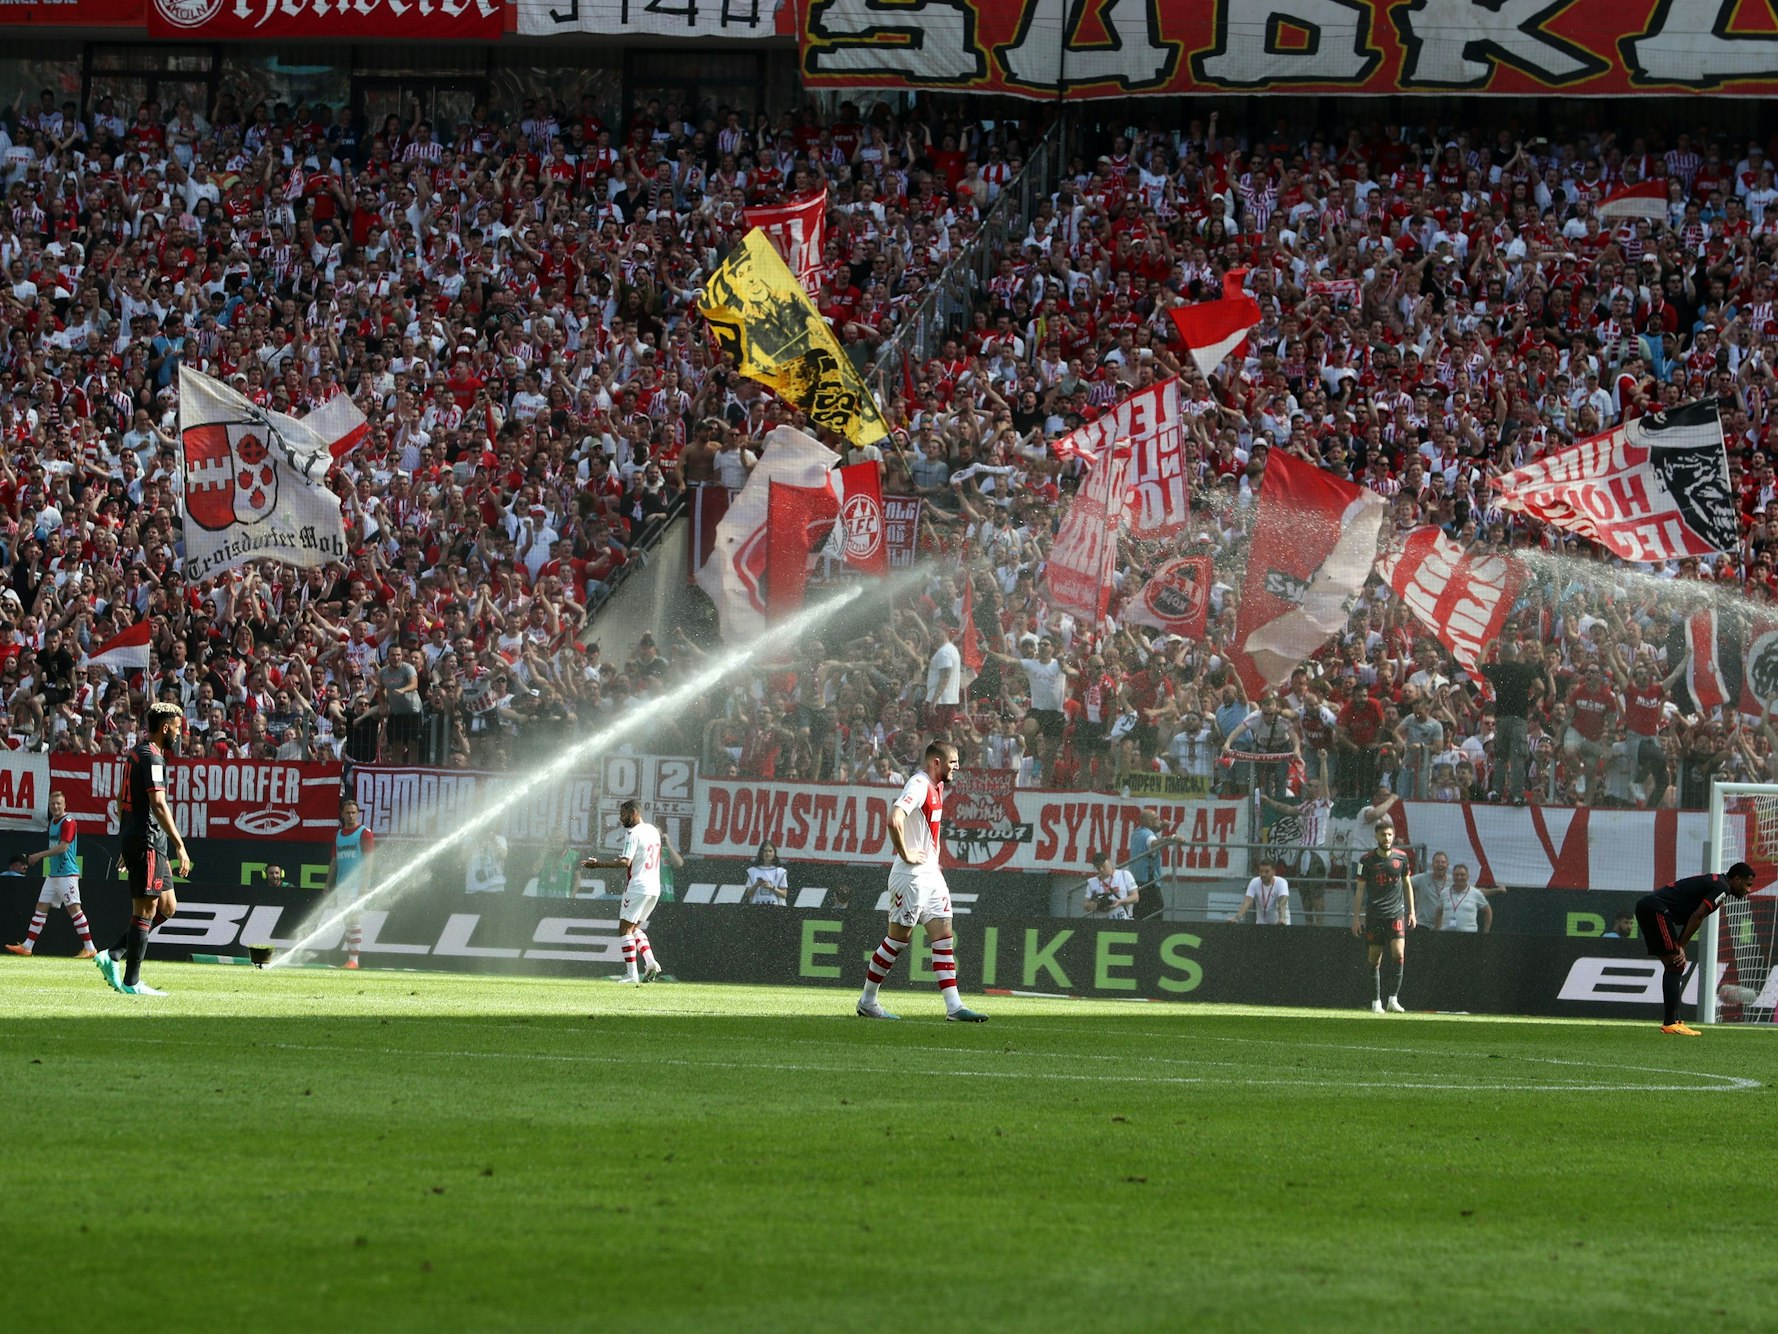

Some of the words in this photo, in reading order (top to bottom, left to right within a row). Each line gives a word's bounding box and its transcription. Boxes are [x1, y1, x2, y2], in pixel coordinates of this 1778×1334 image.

[299, 526, 345, 557] Mob
[659, 762, 690, 798] 2
[703, 786, 896, 856] DOMSTAD
[975, 827, 1028, 841] 2007
[1035, 802, 1237, 870] SYNDKAT
[645, 843, 661, 869] 37
[152, 902, 650, 963] BULLS
[797, 919, 1204, 994] E-BIKES
